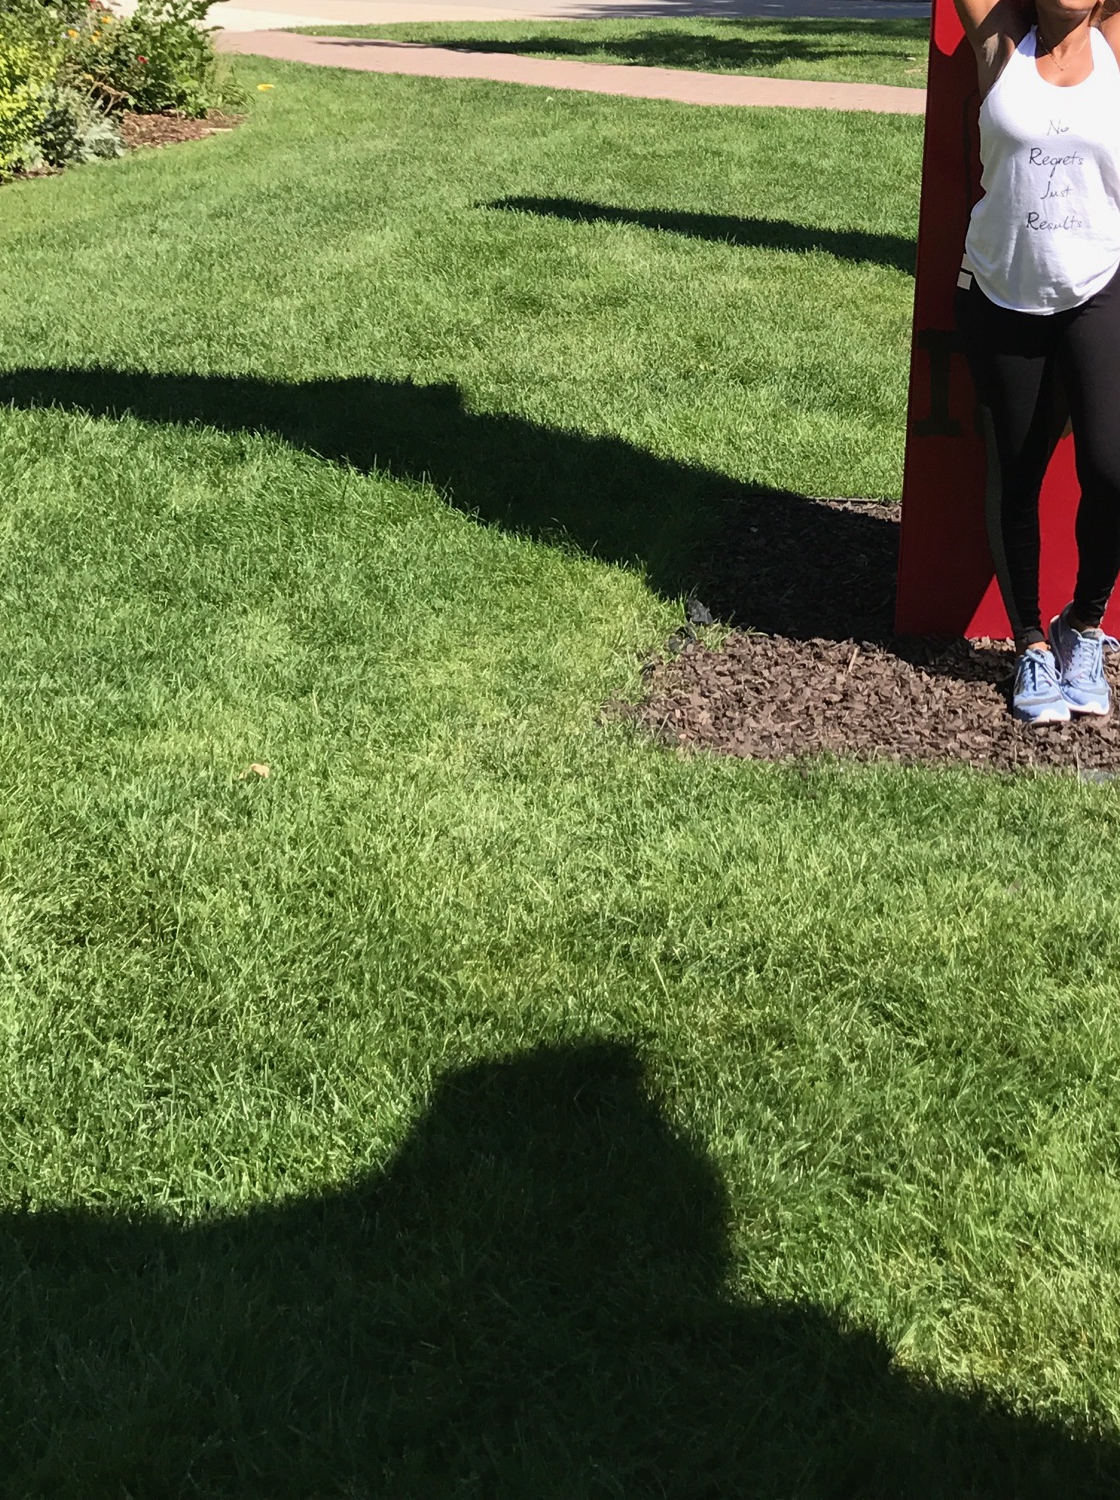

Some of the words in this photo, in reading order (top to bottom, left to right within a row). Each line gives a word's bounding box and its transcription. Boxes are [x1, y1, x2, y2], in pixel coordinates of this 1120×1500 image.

[1046, 117, 1070, 136] No
[1029, 147, 1084, 178] Regrets
[1040, 180, 1073, 200] Just
[1026, 211, 1082, 231] Results
